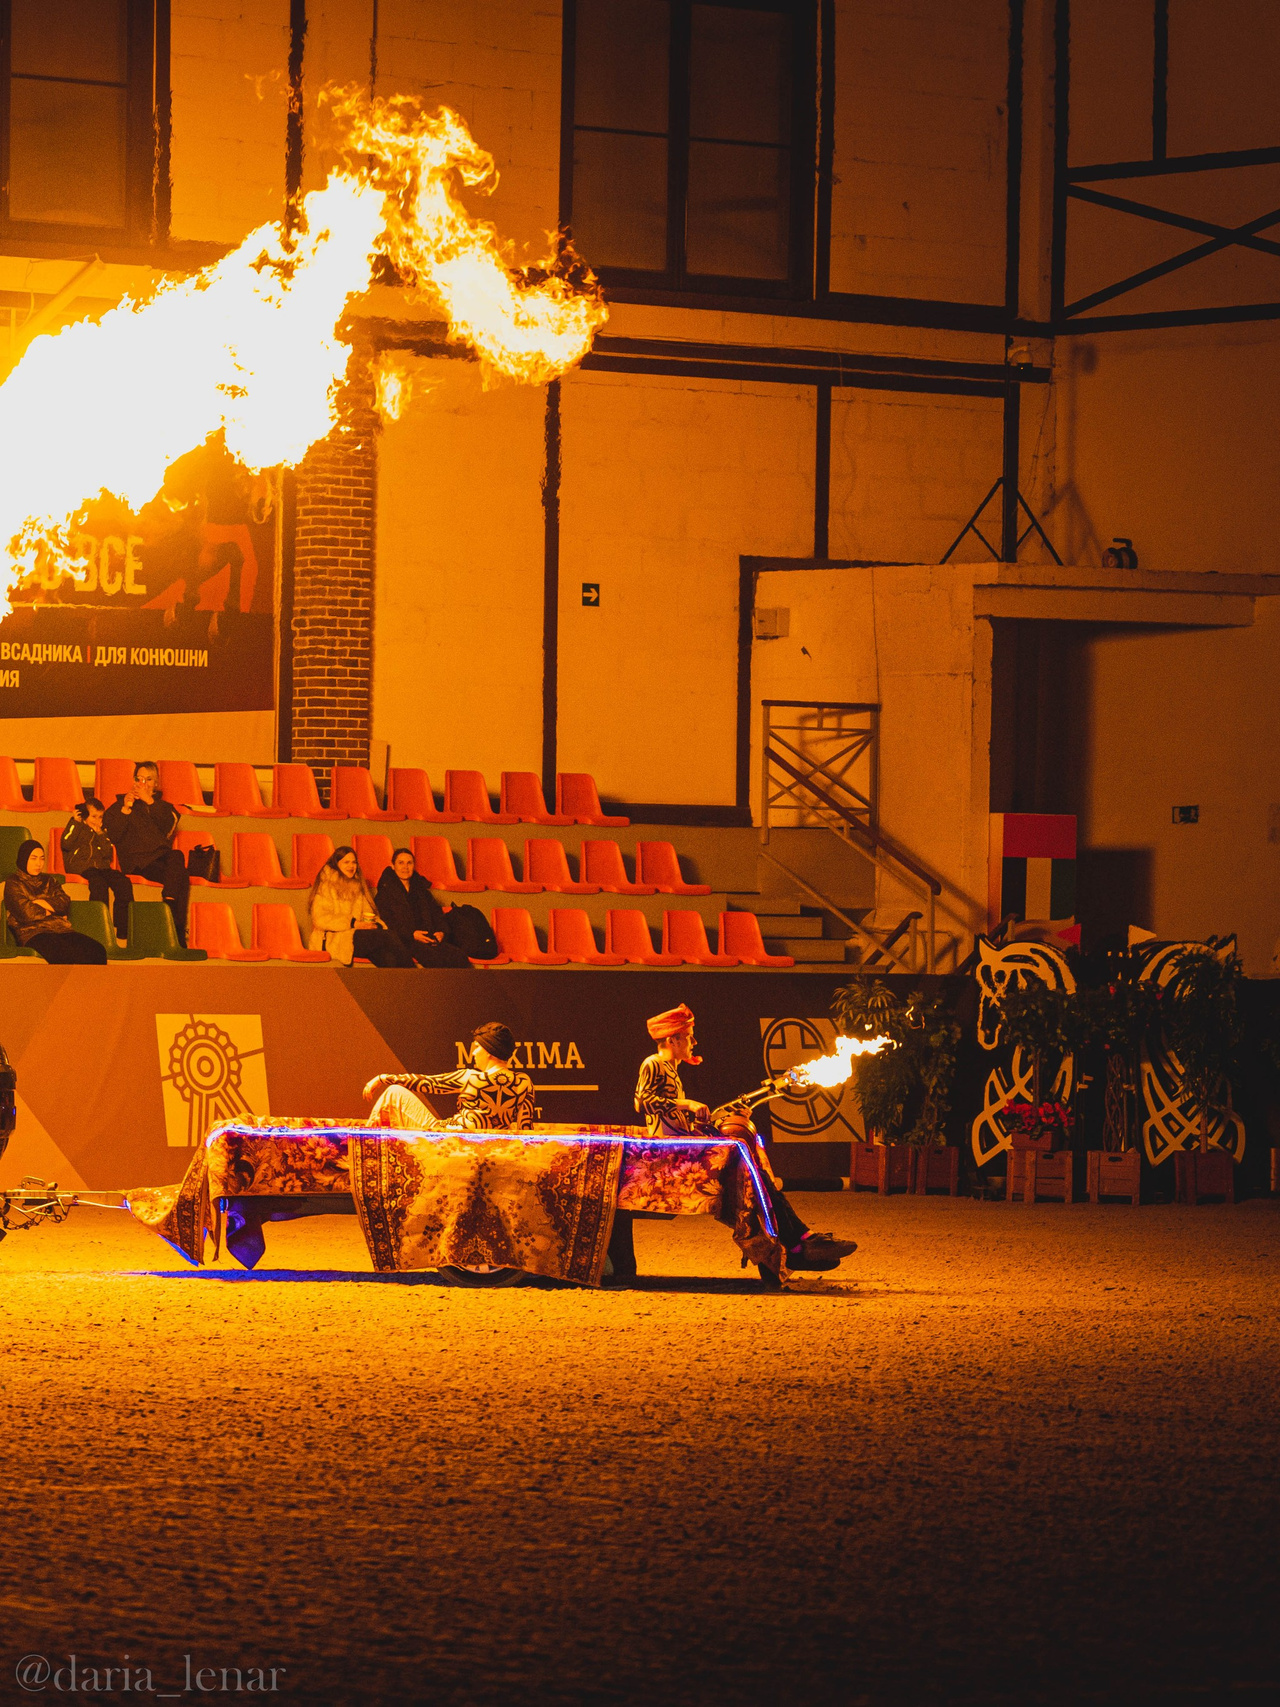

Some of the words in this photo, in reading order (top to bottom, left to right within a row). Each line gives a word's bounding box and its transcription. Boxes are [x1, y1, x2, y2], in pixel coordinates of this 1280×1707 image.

[74, 534, 147, 596] ВСЕ
[0, 641, 82, 664] ВСАДНИКА
[94, 646, 127, 666] ДЛЯ
[130, 648, 208, 668] КОНЮШНИ
[455, 1042, 585, 1068] MXIMA
